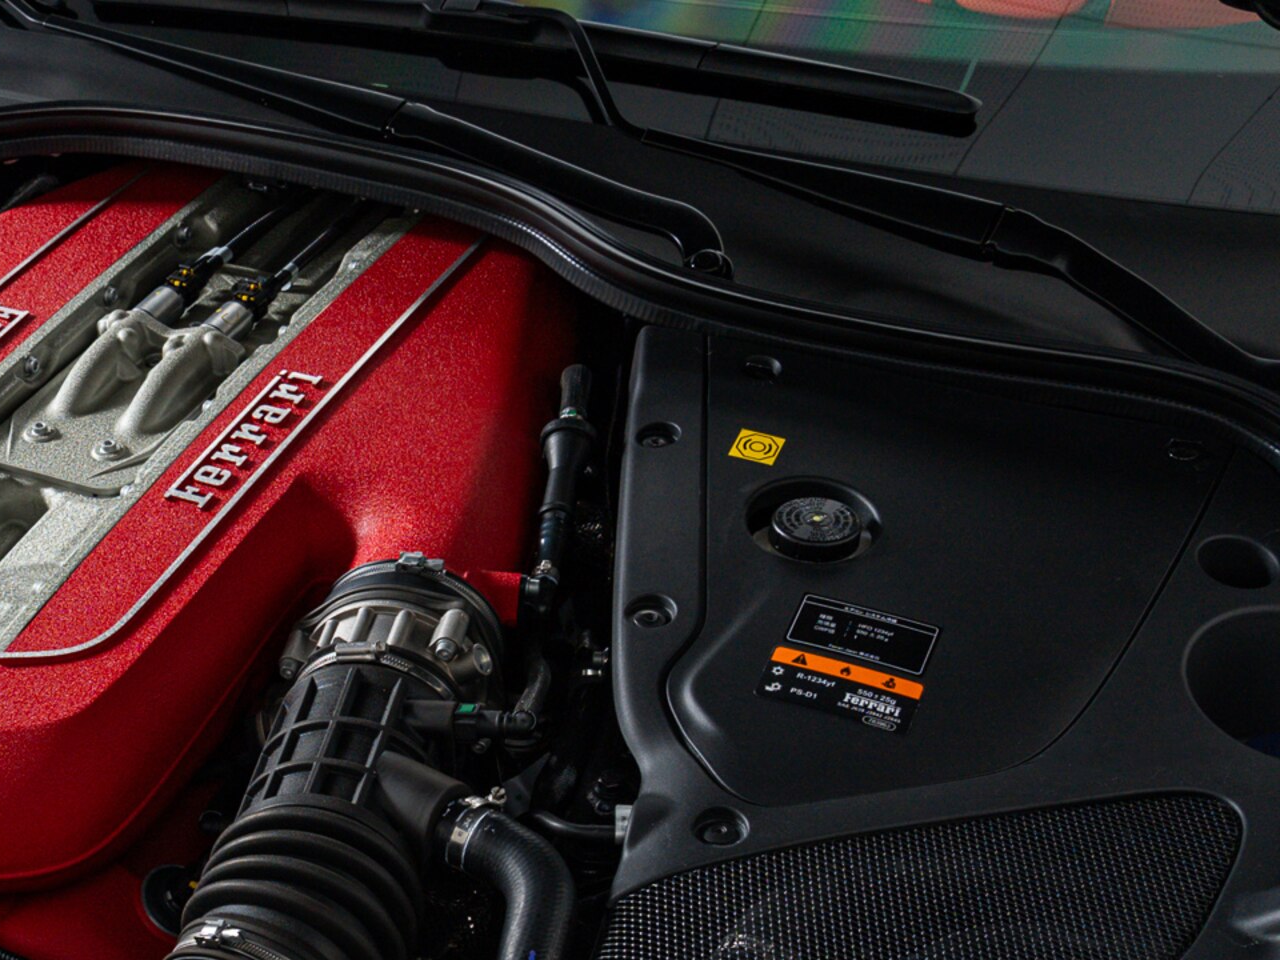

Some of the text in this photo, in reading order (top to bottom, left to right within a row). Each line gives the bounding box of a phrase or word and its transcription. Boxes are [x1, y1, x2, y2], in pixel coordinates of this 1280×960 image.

[164, 370, 325, 511] Ferrari
[796, 672, 835, 687] R-1234yf
[790, 687, 817, 699] PS-D1
[858, 689, 873, 697] 550
[843, 692, 902, 716] Ferrari
